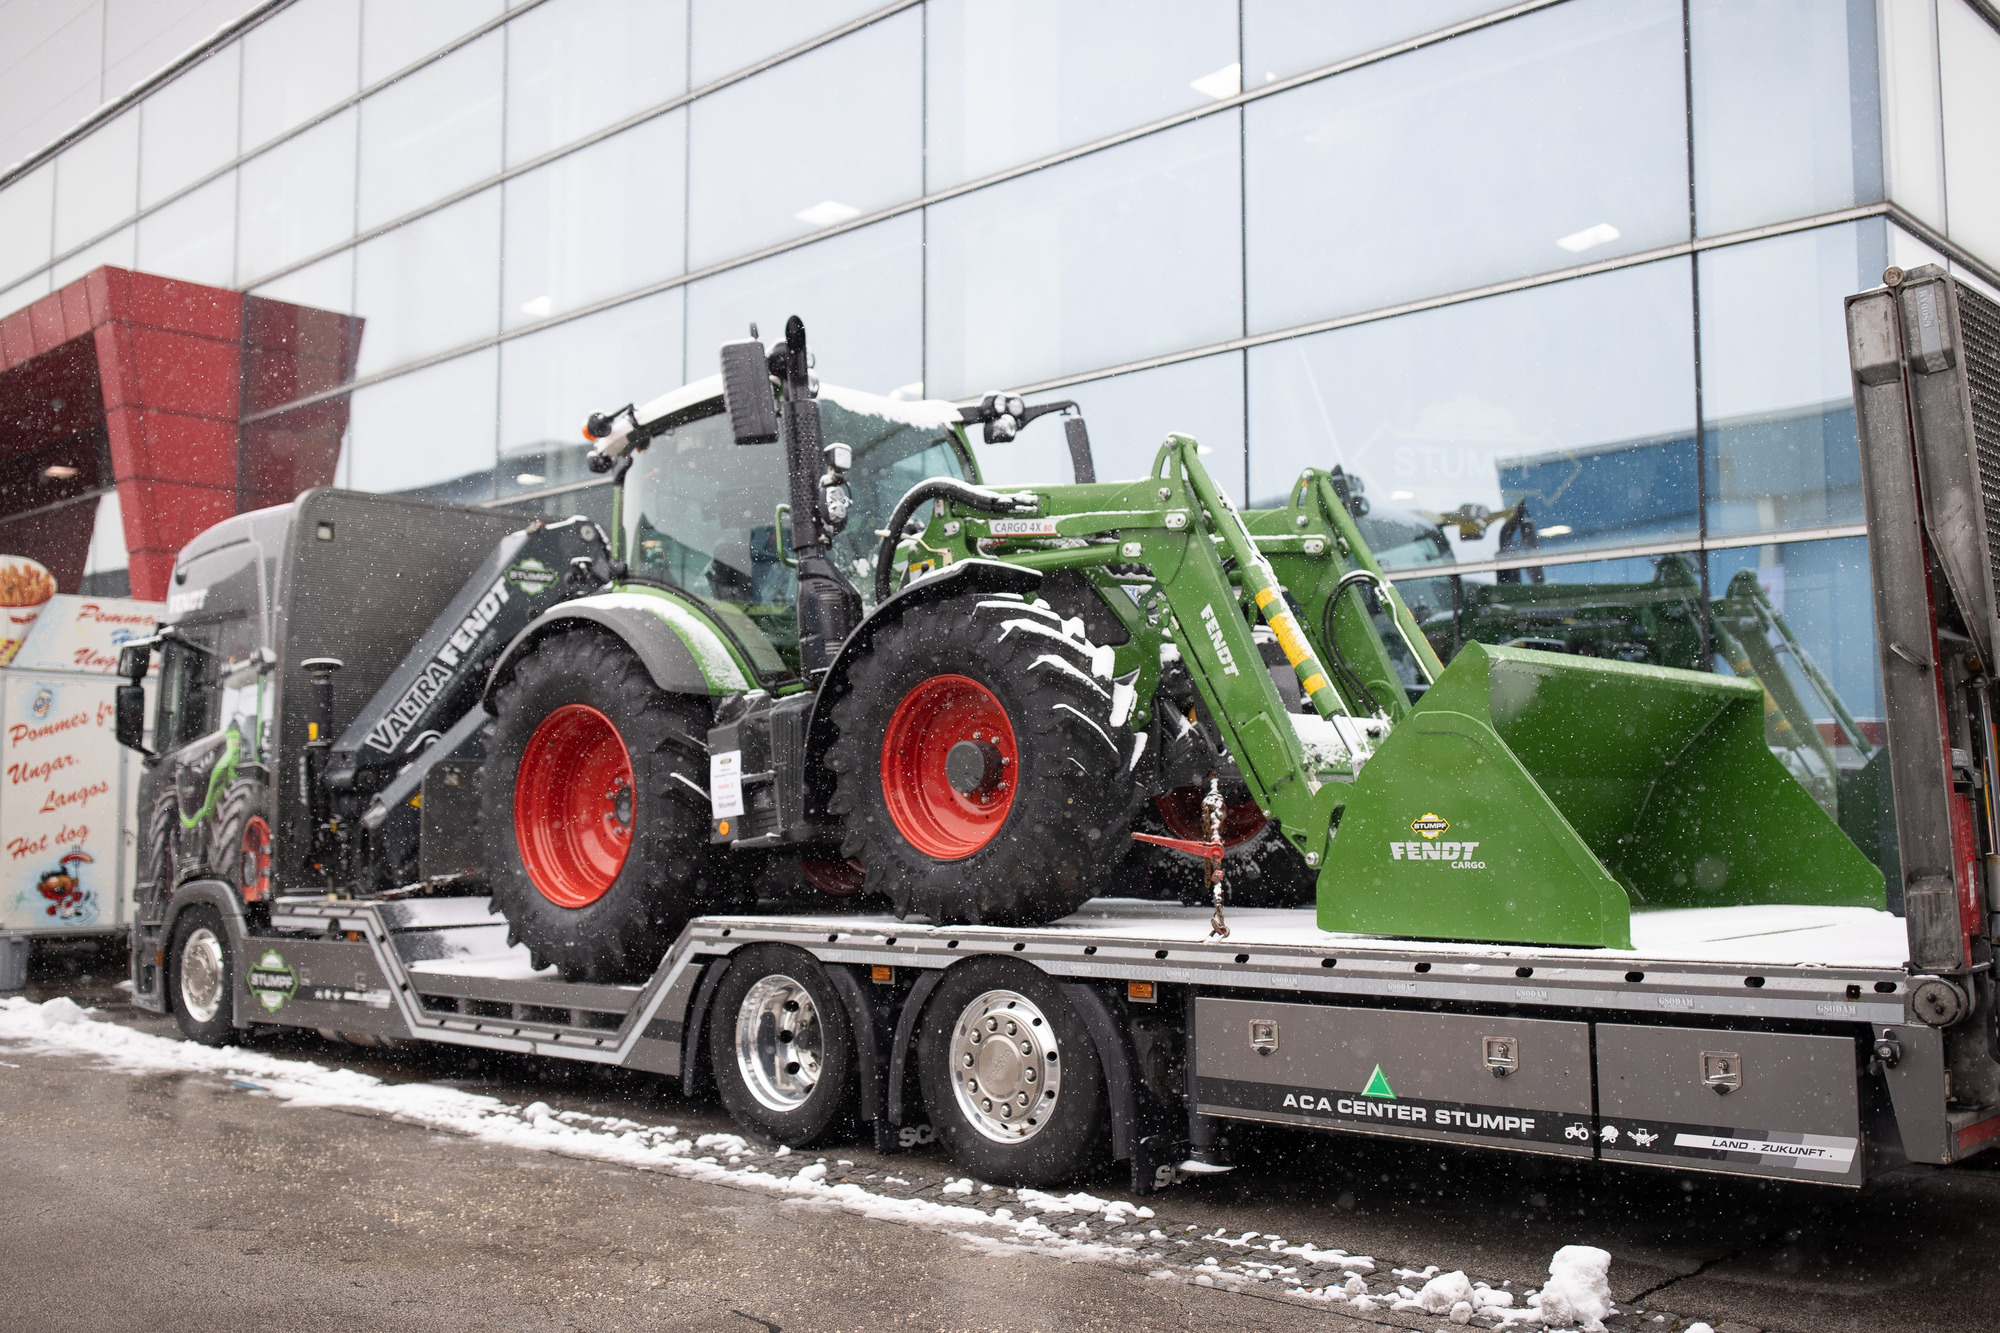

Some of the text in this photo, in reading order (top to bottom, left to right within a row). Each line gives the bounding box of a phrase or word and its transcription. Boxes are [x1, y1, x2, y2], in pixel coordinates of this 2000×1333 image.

[994, 522, 1028, 534] CARGO
[1029, 521, 1042, 533] 4X
[436, 576, 511, 667] FENDT
[1200, 603, 1240, 677] FENDT
[364, 661, 454, 755] VALTRA
[8, 711, 90, 748] Pommes
[39, 780, 109, 815] Langos
[1413, 822, 1447, 830] STUMPF
[6, 823, 90, 861] Hot dog
[1389, 841, 1480, 861] FENDT
[1451, 861, 1486, 869] CARGO
[250, 972, 294, 989] STUMPF
[1658, 996, 1694, 1007] GSODAM
[1817, 1004, 1857, 1015] GSODAM
[1282, 1093, 1536, 1133] ACA CENTER STUMPF
[1711, 1139, 1749, 1150] LAND
[1760, 1143, 1826, 1158] ZUKUNFT
